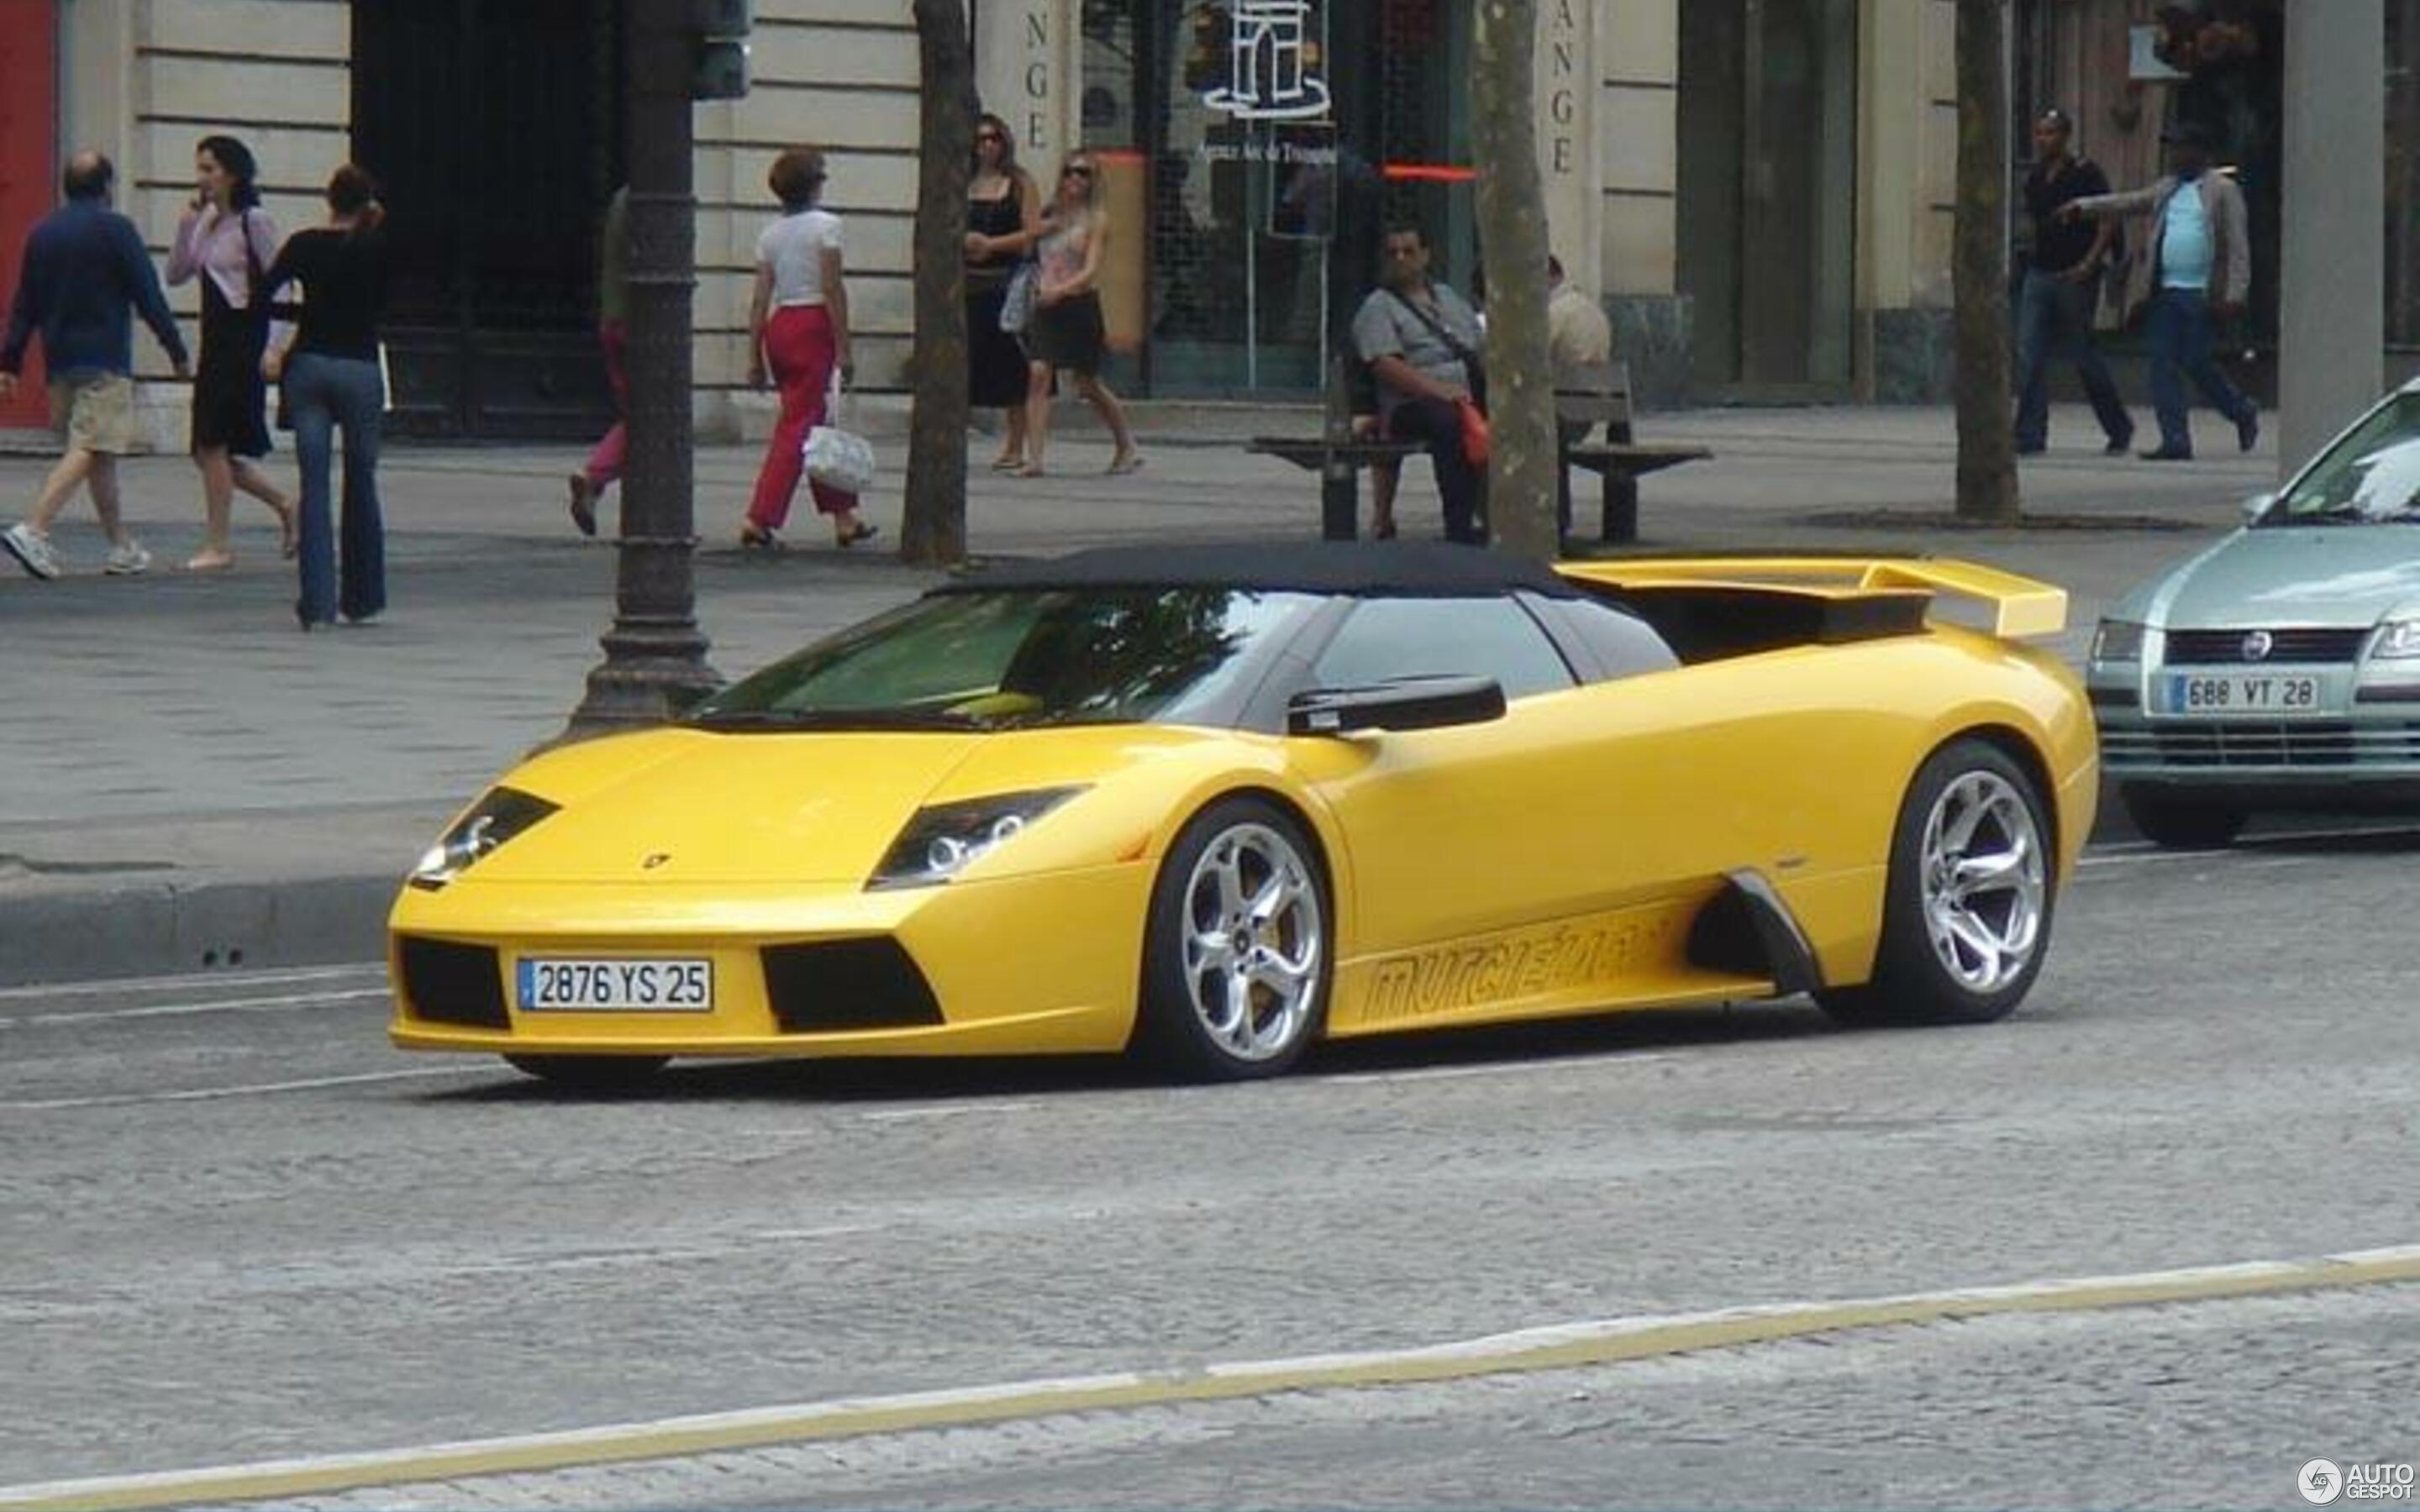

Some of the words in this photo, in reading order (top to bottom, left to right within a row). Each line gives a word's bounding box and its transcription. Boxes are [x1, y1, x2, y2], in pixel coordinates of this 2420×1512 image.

[1025, 0, 1047, 150] NGE
[2189, 680, 2230, 706] 688
[2244, 680, 2274, 706] VT
[2282, 680, 2312, 706] 28
[539, 964, 611, 1003] 2876
[619, 964, 657, 1003] YS
[666, 964, 705, 1003] 25
